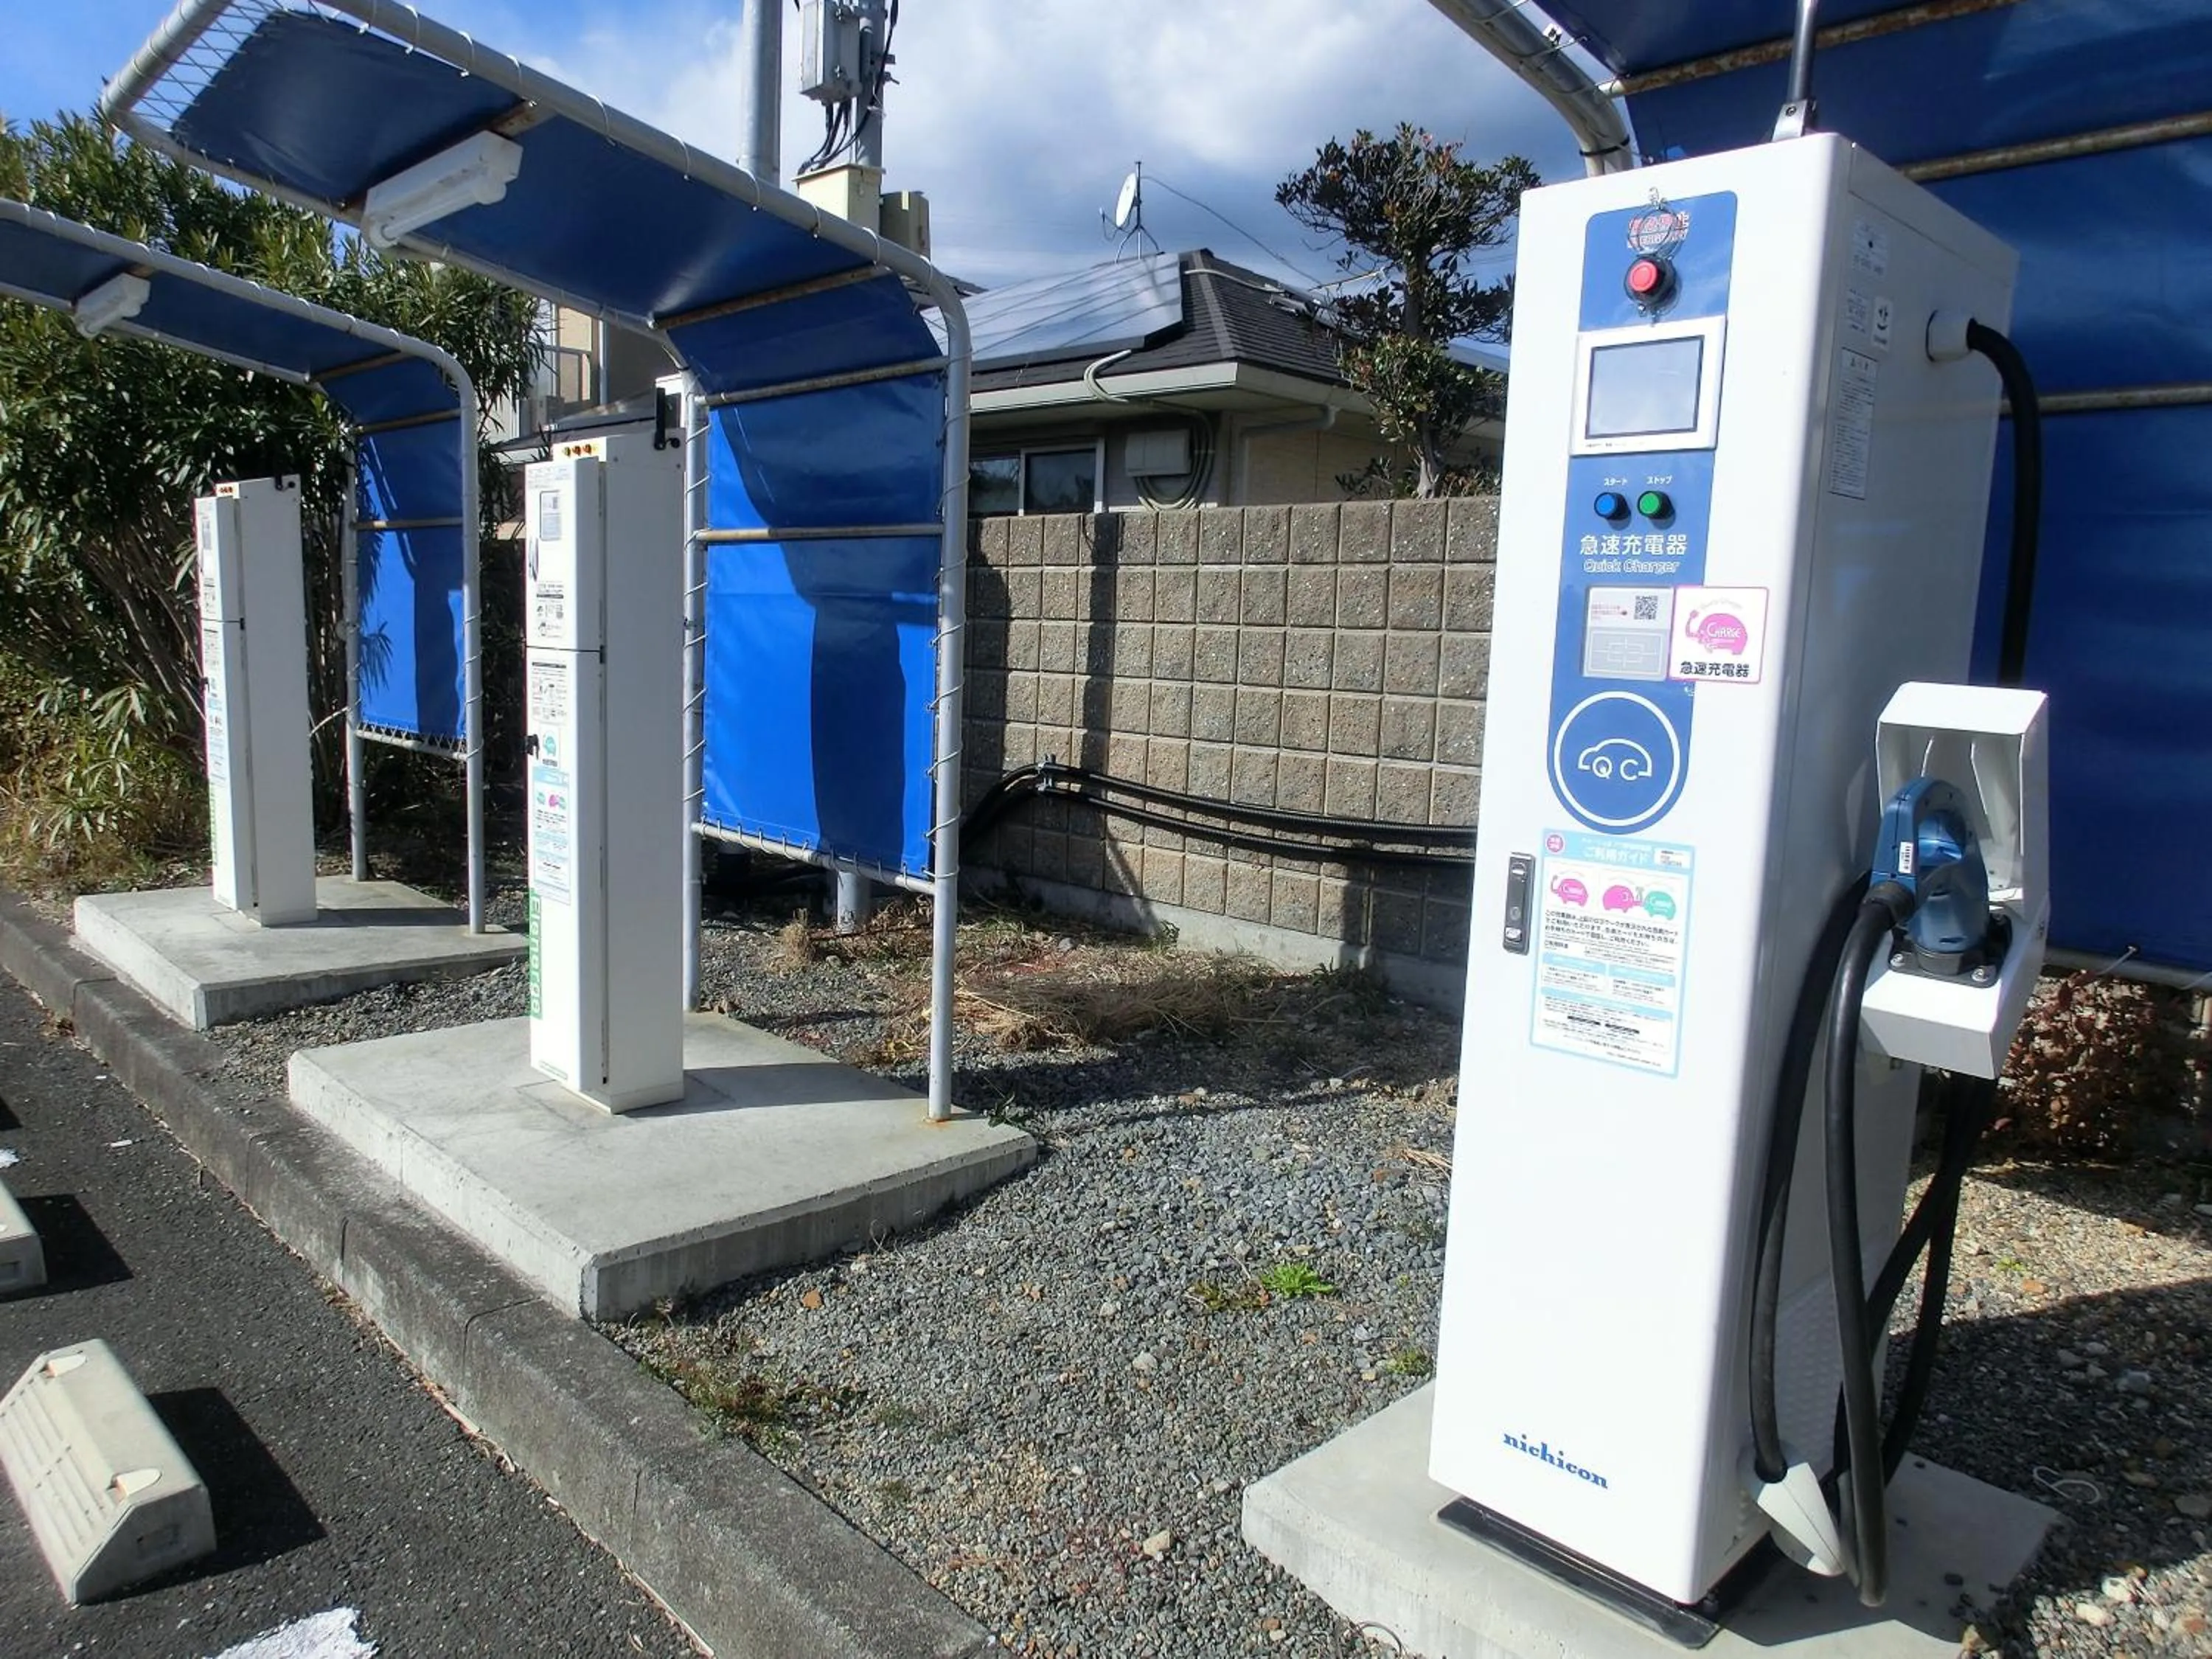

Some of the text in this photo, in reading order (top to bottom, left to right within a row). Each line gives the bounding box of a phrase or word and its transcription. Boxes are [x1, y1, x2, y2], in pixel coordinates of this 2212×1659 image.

[1604, 476, 1628, 487] スタート
[1646, 474, 1673, 485] ストップ
[1580, 534, 1688, 555] 急速充電器
[1583, 558, 1680, 574] Quick Charger
[1680, 661, 1750, 678] 急速充電器
[1503, 1433, 1609, 1489] nichicon
